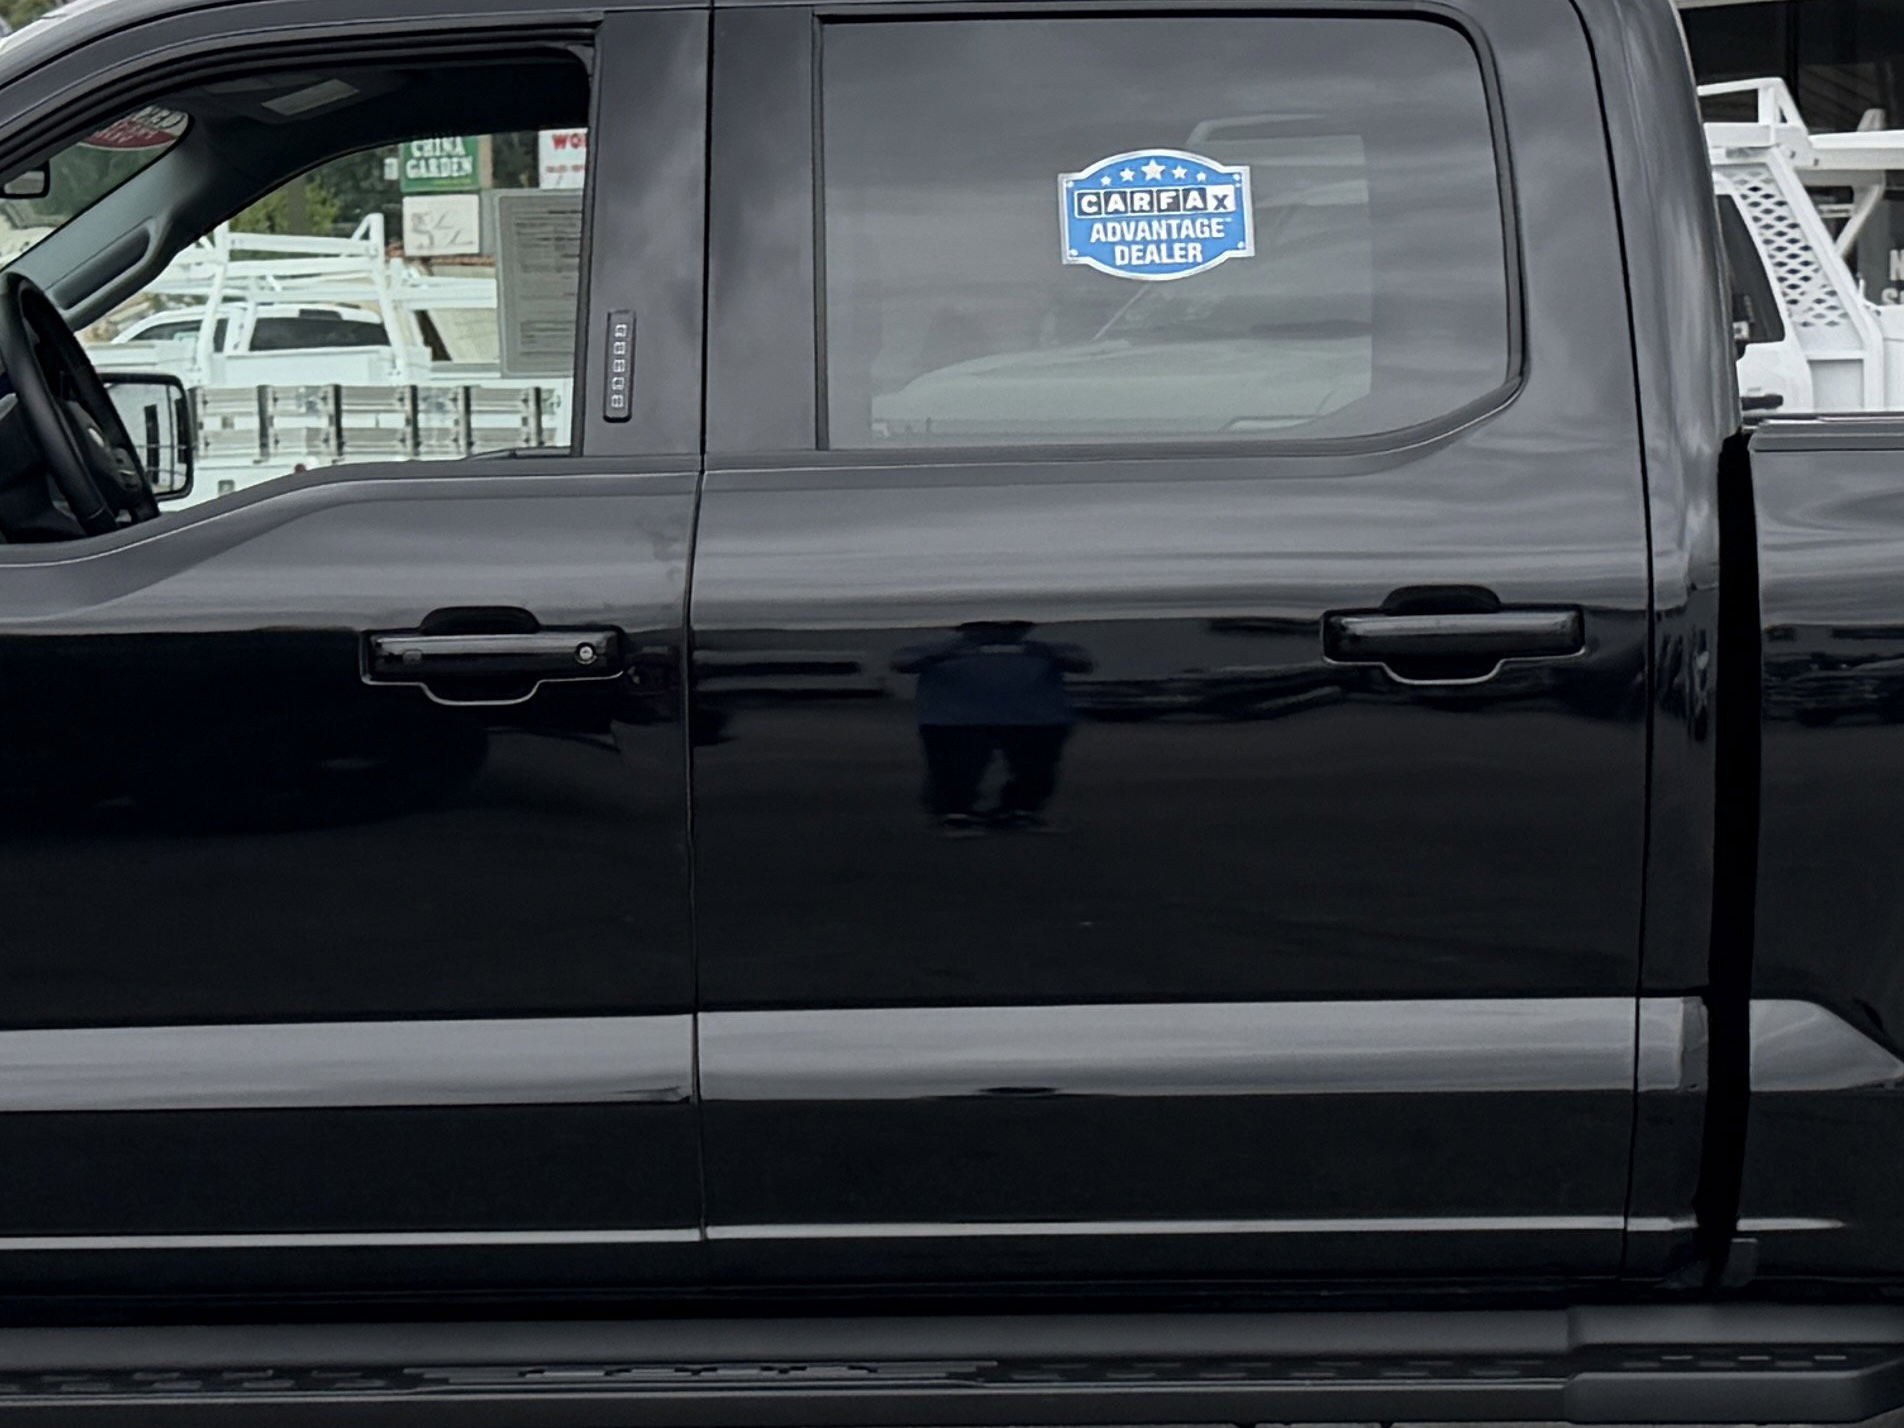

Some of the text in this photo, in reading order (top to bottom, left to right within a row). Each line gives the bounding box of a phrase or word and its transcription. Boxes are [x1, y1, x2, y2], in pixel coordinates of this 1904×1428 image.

[411, 137, 465, 157] CHINA
[406, 156, 473, 178] GARDEN
[1078, 187, 1233, 214] CARFAX
[1114, 243, 1203, 266] DEALER
